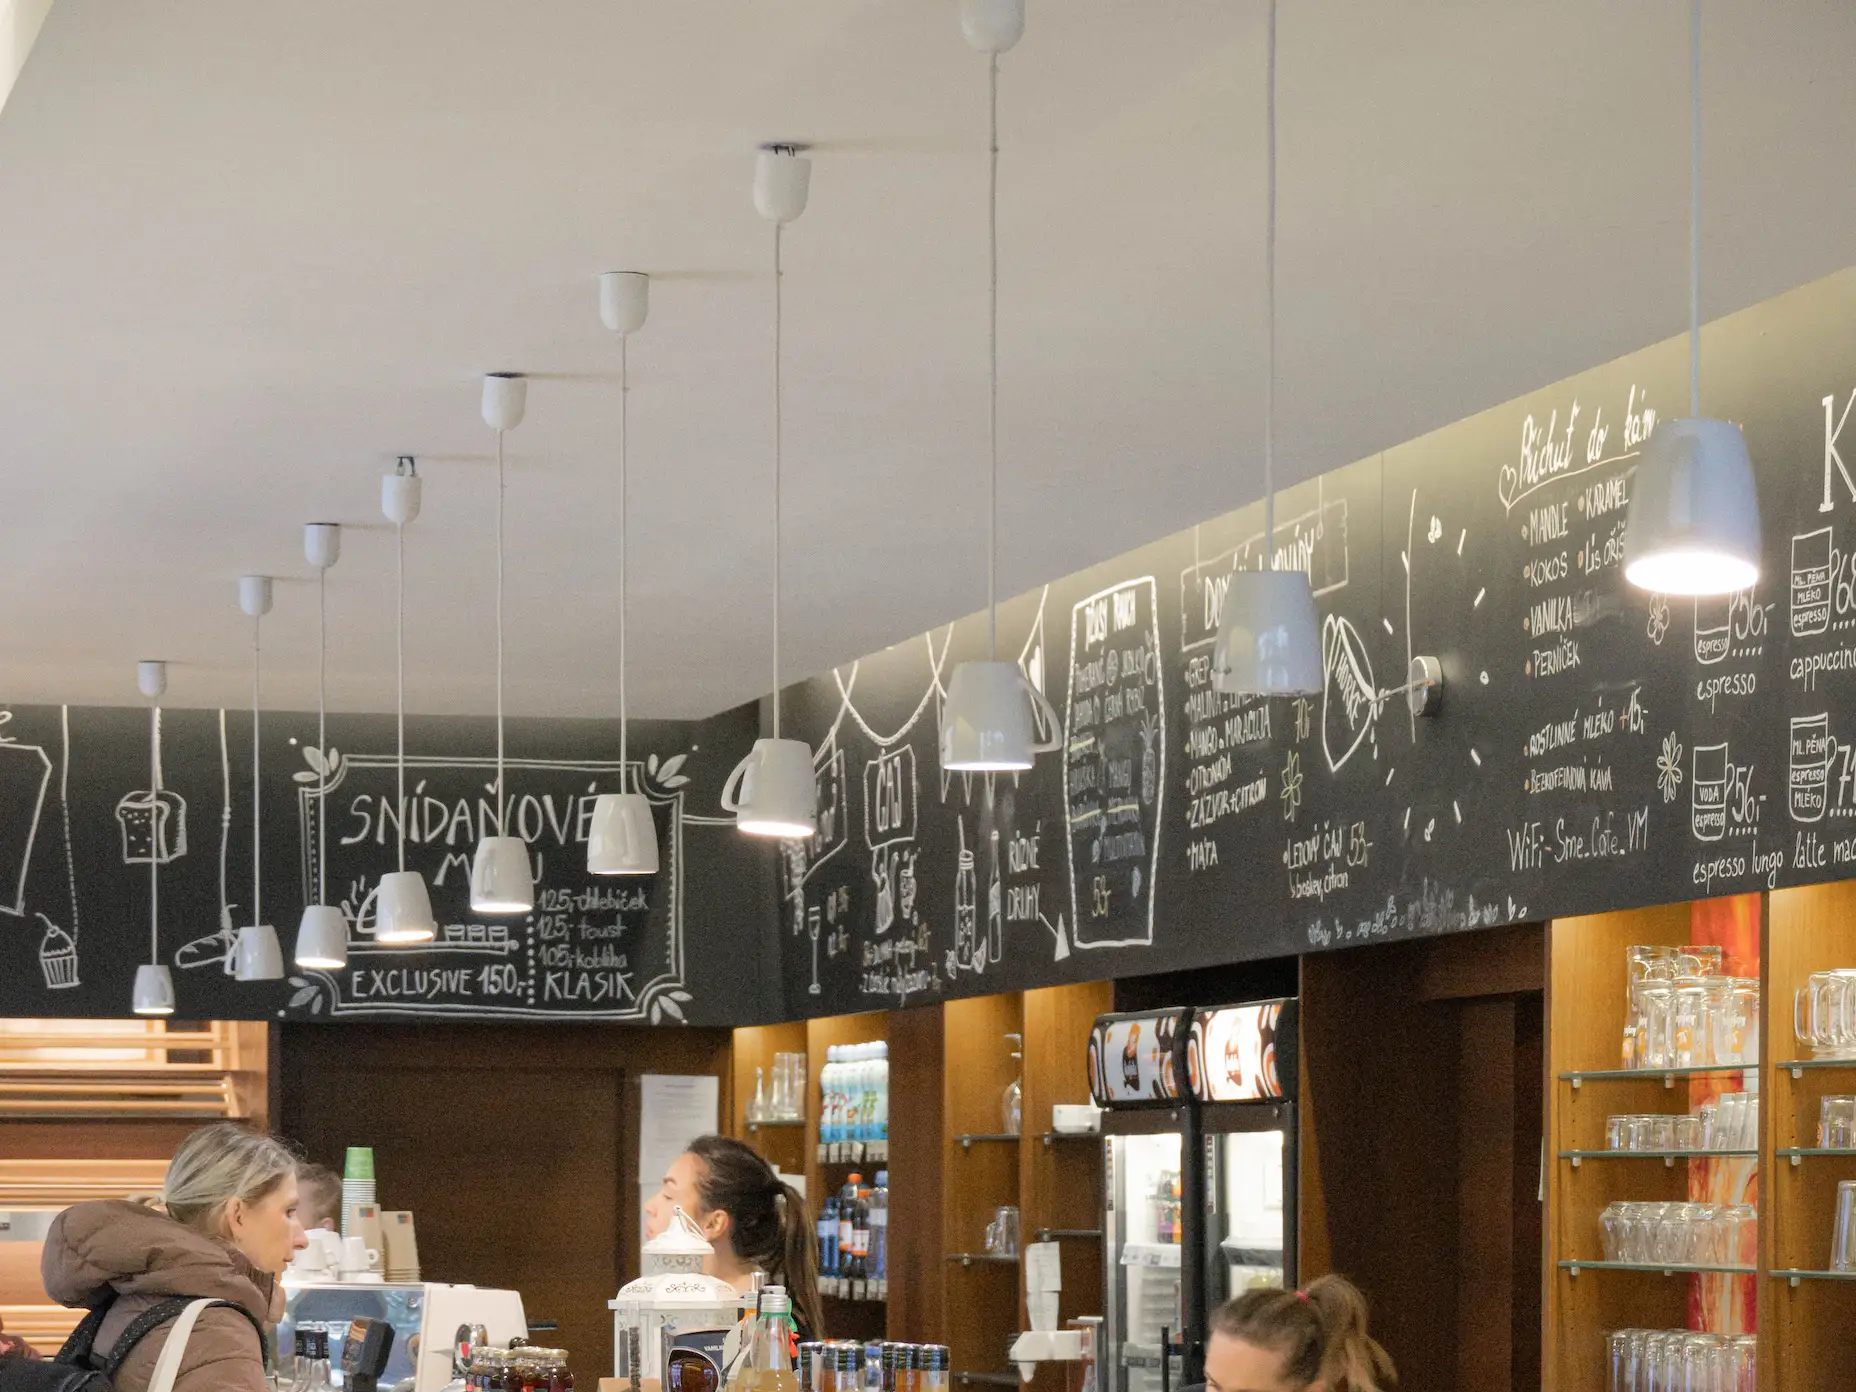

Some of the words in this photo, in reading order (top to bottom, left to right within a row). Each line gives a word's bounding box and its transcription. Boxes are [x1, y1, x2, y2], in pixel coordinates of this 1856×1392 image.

[1585, 479, 1629, 521] KARAMEL
[1530, 502, 1569, 547] MANDLE
[1530, 551, 1568, 588] KOKOS
[1797, 584, 1821, 604] MLÉKO
[1530, 595, 1573, 636] VANILKA
[1793, 607, 1827, 630] espresso
[1697, 636, 1728, 659] espresso
[1697, 673, 1756, 715] espresso
[1583, 696, 1615, 740] MLÉKO
[1699, 786, 1720, 802] VODA
[1791, 768, 1825, 785] espresso
[340, 779, 602, 846] SNÍDAŇOVÉ
[1794, 787, 1822, 809] MLÉKO
[1323, 819, 1343, 860] ČAJ
[1695, 811, 1725, 834] espresso
[1693, 857, 1746, 895] espresso
[1752, 839, 1784, 889] lungo
[1792, 831, 1827, 868] latte
[352, 969, 473, 999] EXCLUSIVE
[543, 971, 636, 1002] KLASIK
